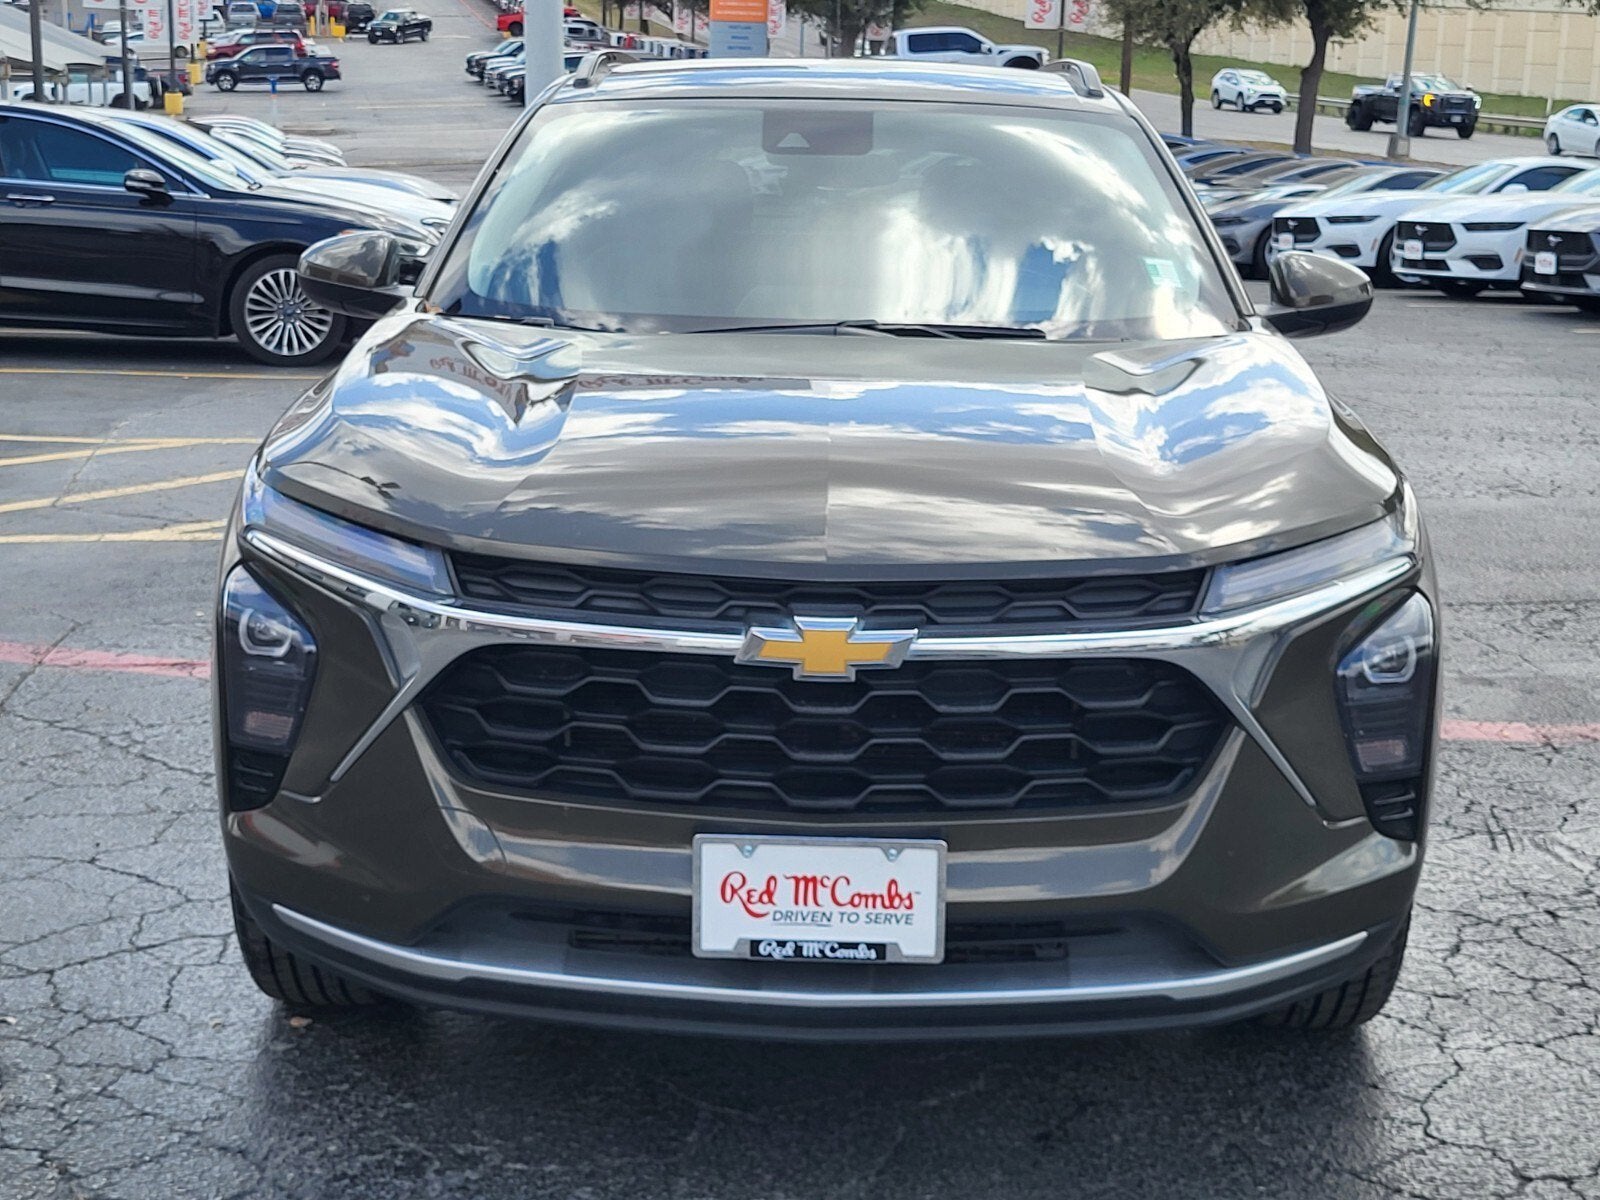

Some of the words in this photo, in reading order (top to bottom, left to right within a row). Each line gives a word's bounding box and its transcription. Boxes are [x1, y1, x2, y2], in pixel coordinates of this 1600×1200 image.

[721, 871, 777, 918] Red
[772, 910, 832, 923] DRIVEN
[839, 911, 860, 924] TO
[864, 912, 914, 925] SERVE
[758, 939, 795, 960] Red
[797, 941, 877, 961] McCombs
